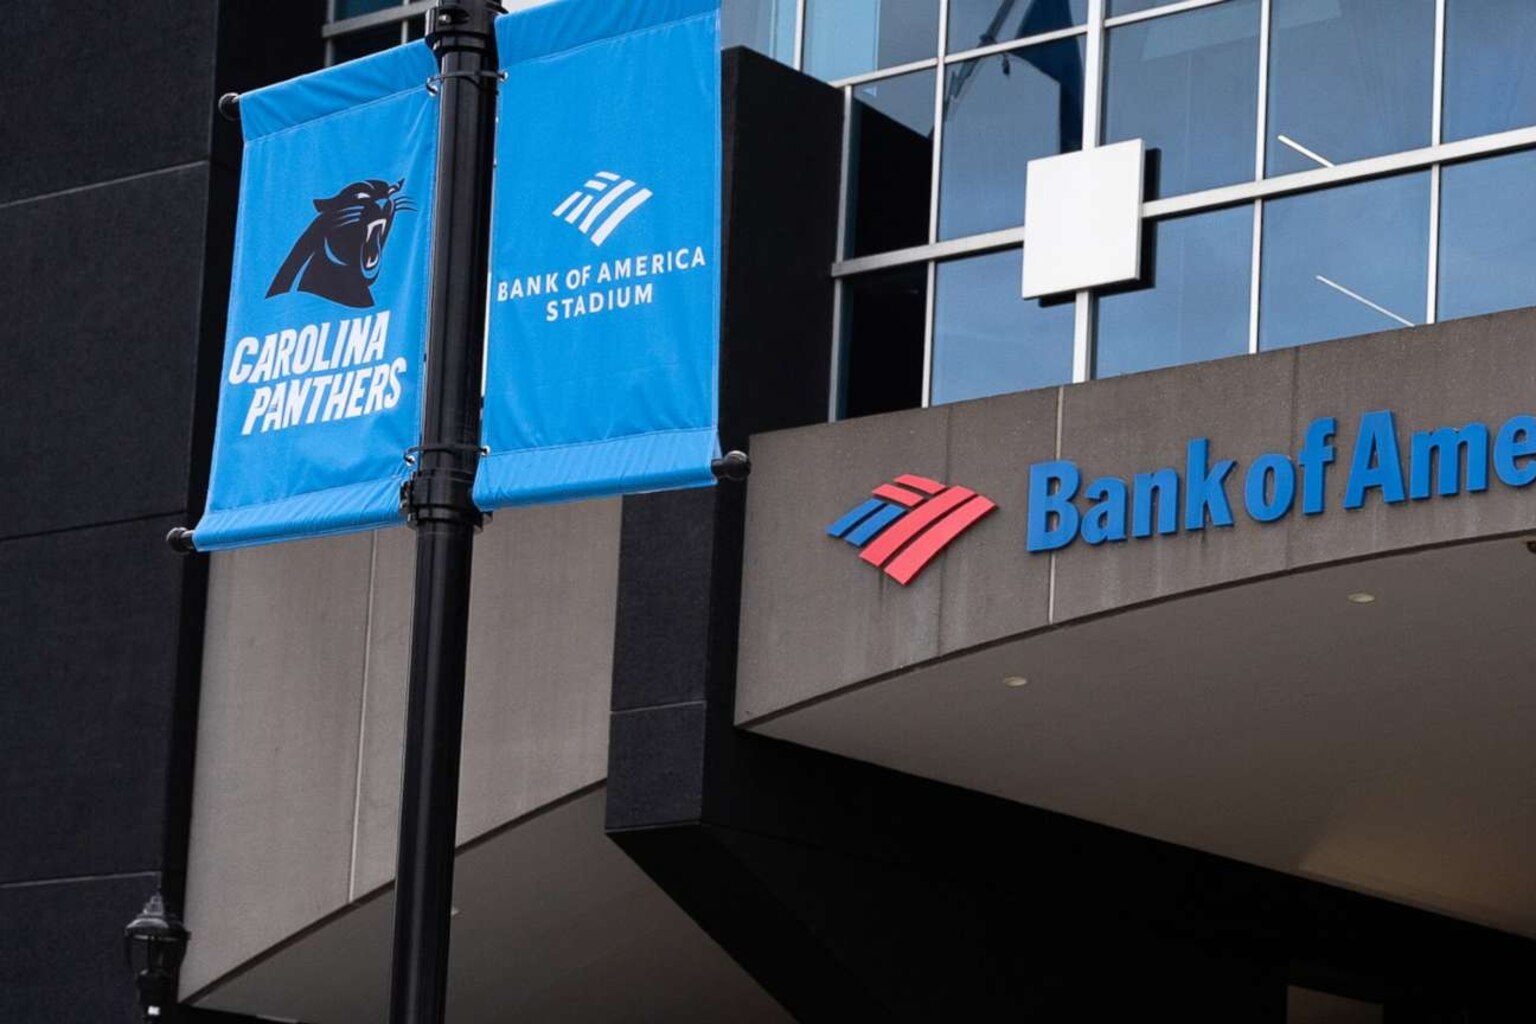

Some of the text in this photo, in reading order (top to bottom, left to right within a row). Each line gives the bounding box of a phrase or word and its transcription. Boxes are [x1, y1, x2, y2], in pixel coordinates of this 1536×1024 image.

[496, 247, 707, 302] BANK OF AMERICA
[546, 284, 654, 321] STADIUM
[228, 311, 391, 385] CAROLINA
[241, 358, 407, 435] PANTHERS
[1028, 439, 1233, 552] Bank
[1245, 418, 1335, 522] of
